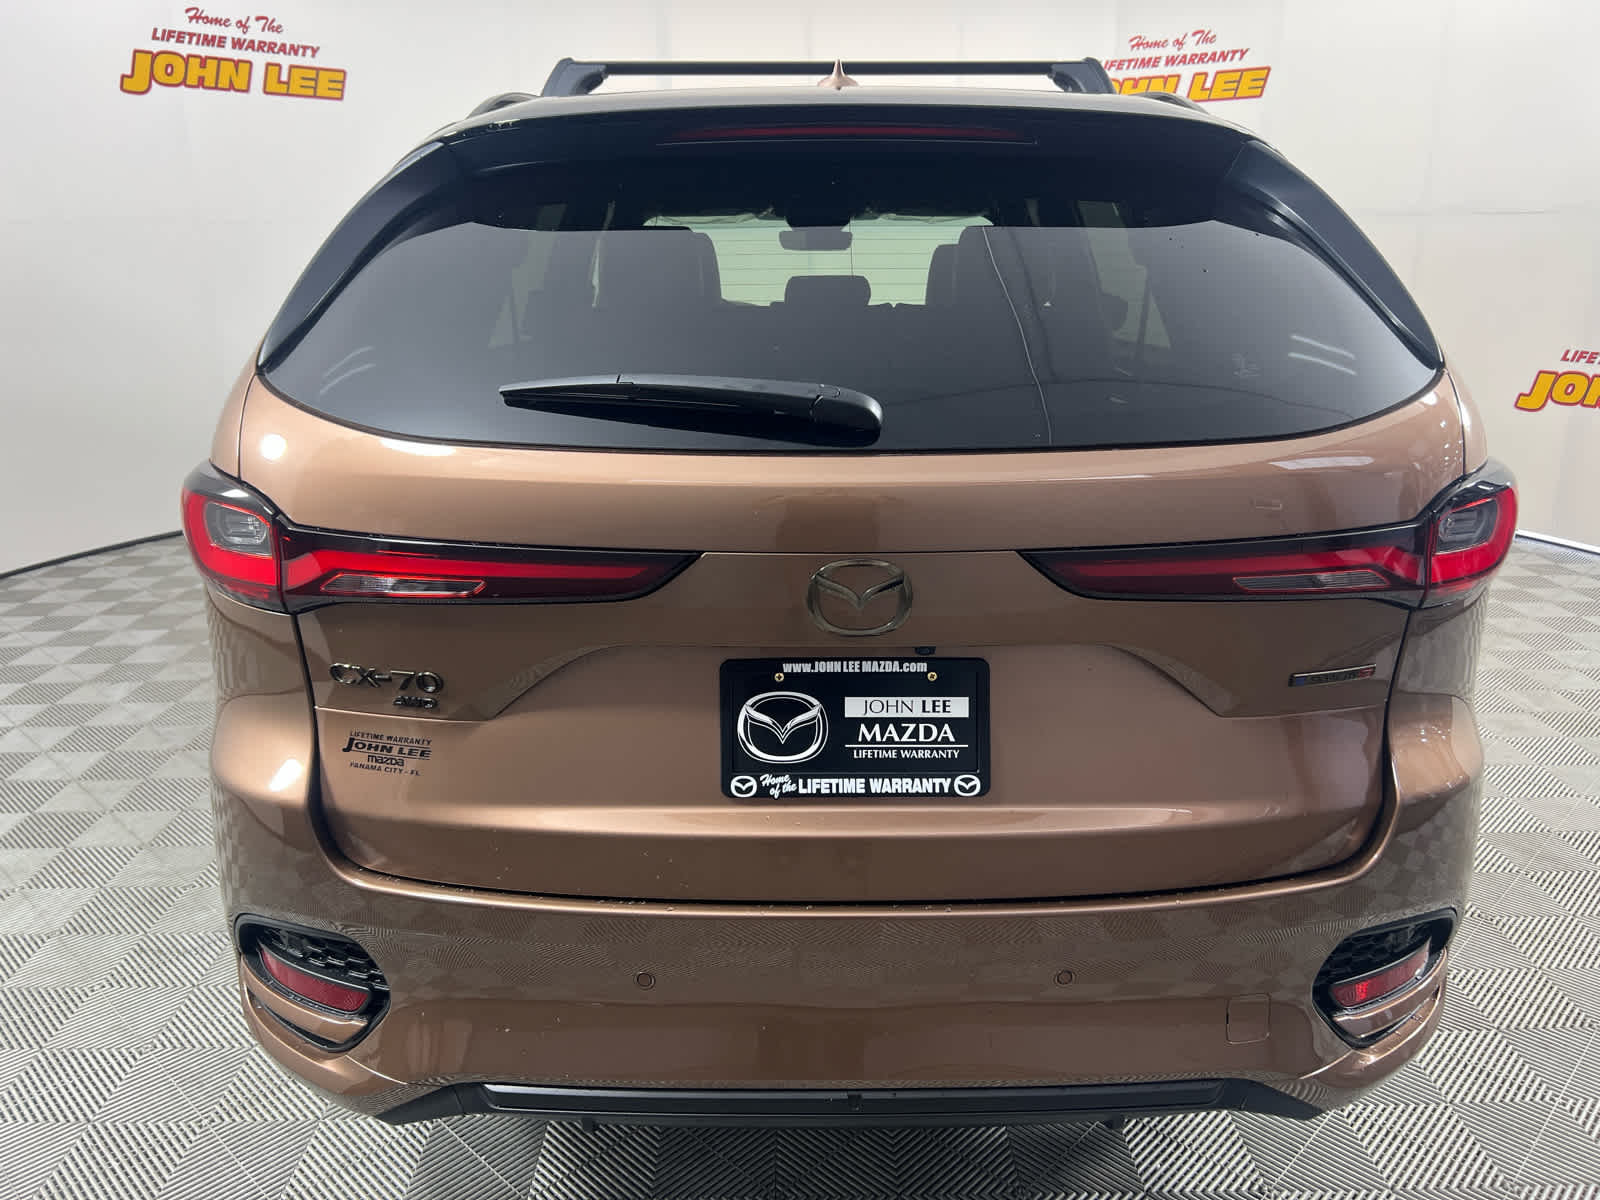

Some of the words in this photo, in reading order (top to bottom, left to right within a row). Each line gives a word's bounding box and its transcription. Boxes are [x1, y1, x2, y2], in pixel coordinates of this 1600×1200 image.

[185, 6, 231, 28] Home
[235, 16, 251, 34] of
[255, 16, 284, 34] The
[151, 27, 227, 48] LIFETIME
[231, 36, 320, 58] WARRANTY
[1128, 35, 1168, 51] Home
[1172, 33, 1187, 51] of
[1191, 29, 1217, 45] The
[1103, 56, 1161, 71] IFETIME
[1165, 48, 1250, 67] WARRANTY
[120, 49, 253, 95] JOHN
[263, 62, 346, 100] LEE
[1187, 66, 1271, 103] LEE
[329, 663, 444, 693] CX-70
[863, 699, 914, 716] JOHN
[921, 700, 951, 714] LEE
[350, 731, 384, 741] LIFETIME
[386, 735, 432, 745] WARRANTY
[858, 723, 956, 743] MAZDA
[342, 738, 393, 753] JOHN
[397, 746, 432, 758] LEE
[853, 749, 898, 759] LIFETIME
[900, 749, 960, 759] WARRANTY
[350, 761, 381, 772] PANAMA
[760, 773, 790, 787] Home
[769, 783, 781, 799] of
[782, 779, 798, 793] the
[798, 778, 866, 794] LIFETIME
[870, 778, 951, 794] WARRANTY
